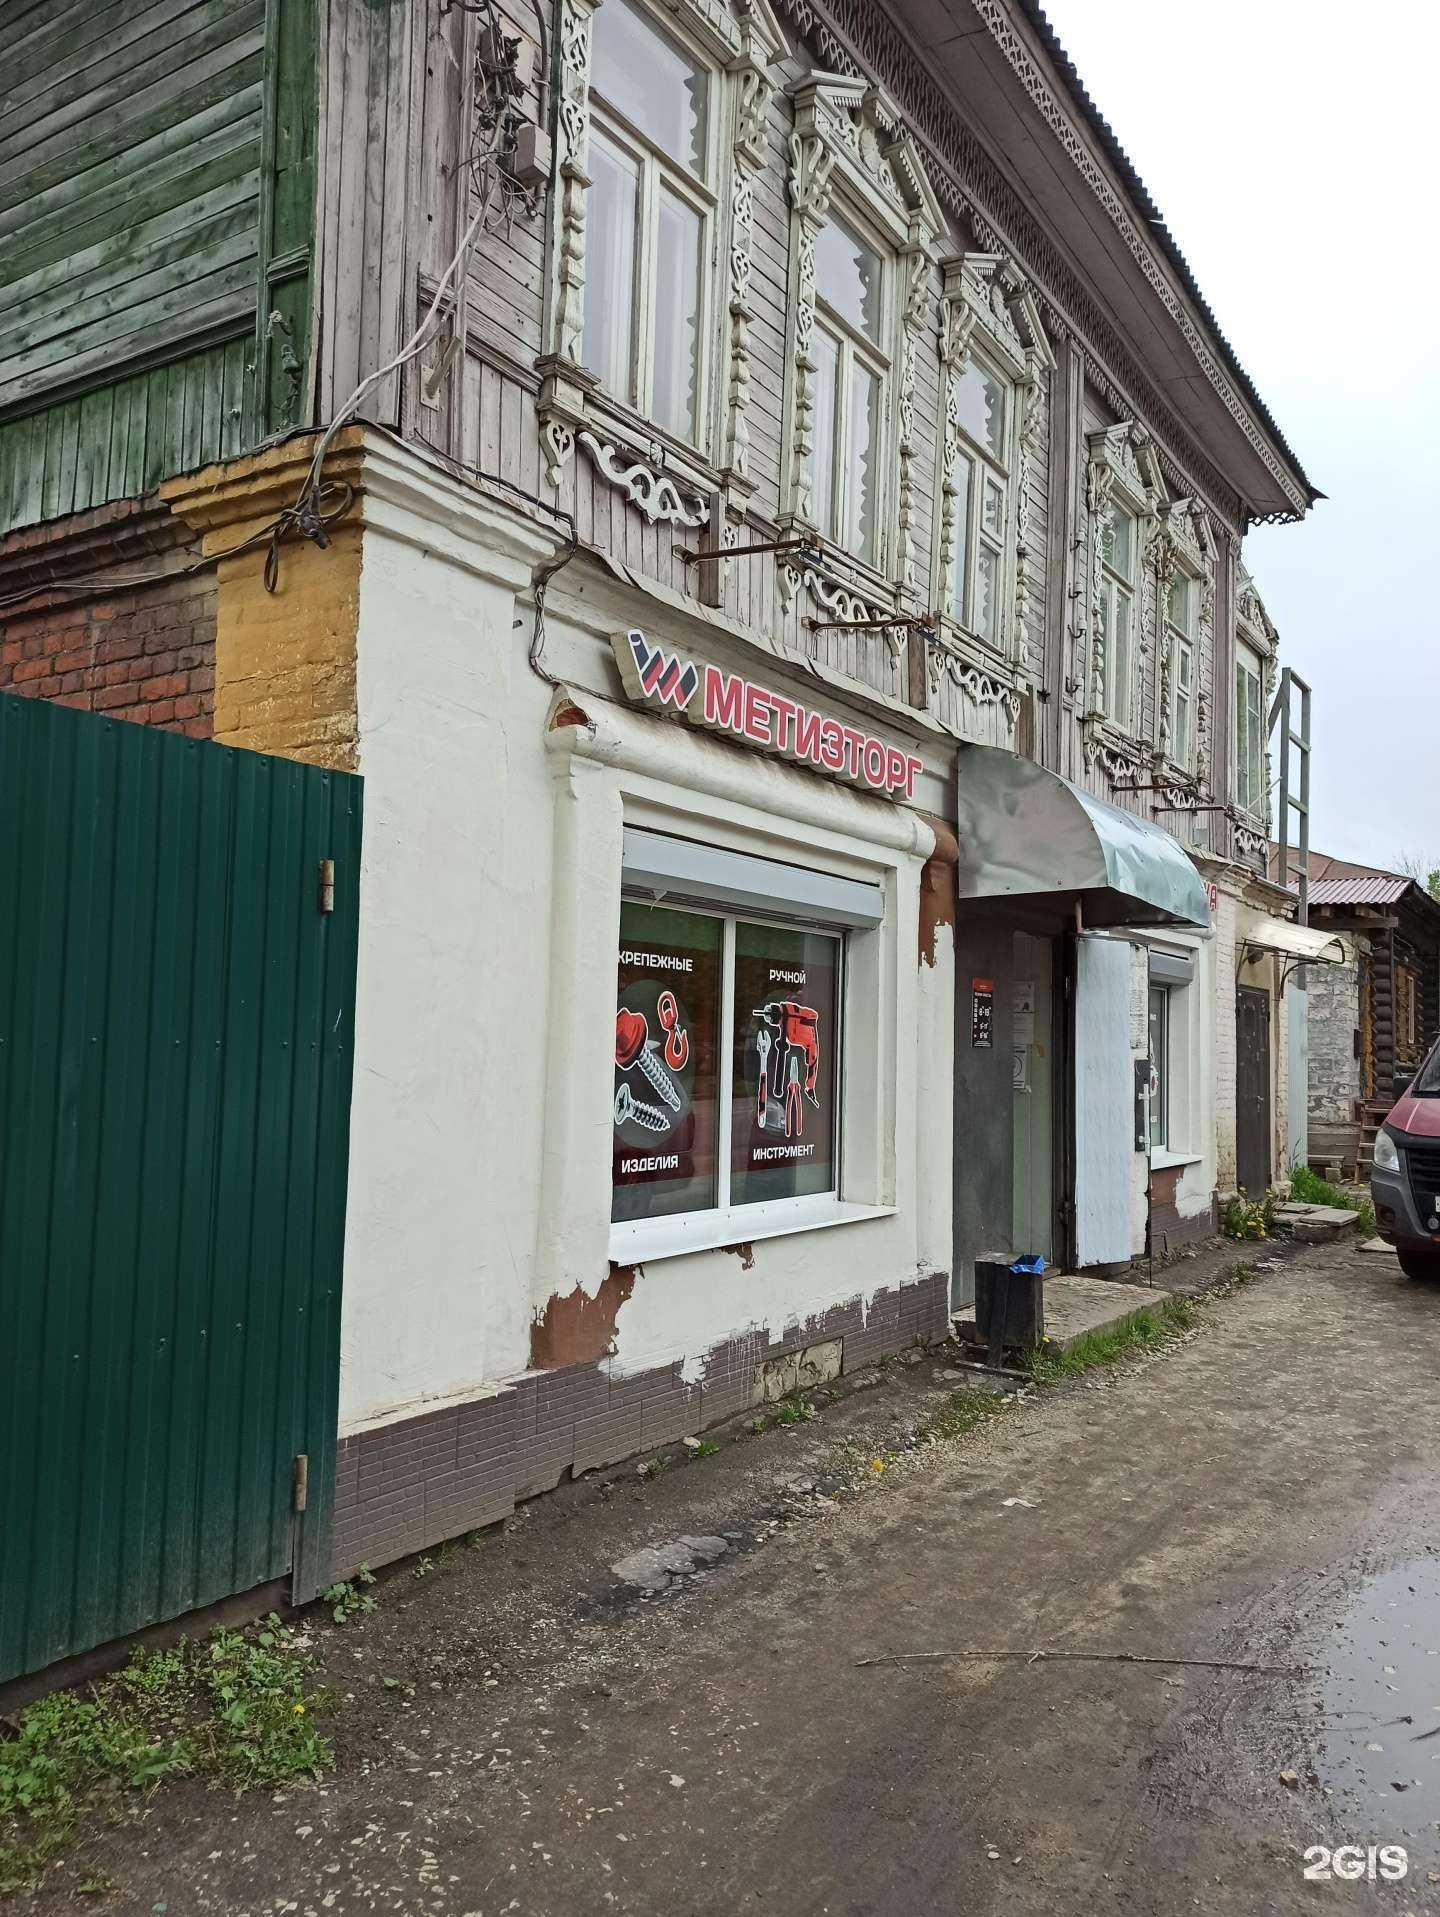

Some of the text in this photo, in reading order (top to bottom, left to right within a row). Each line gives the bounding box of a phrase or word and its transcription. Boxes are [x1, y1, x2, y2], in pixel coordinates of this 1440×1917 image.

[704, 664, 923, 800] МЕТИЗТОРГ
[769, 969, 806, 985] РУЧНОЙ
[753, 1143, 815, 1161] ИНСТРУМЕНТ
[621, 1154, 679, 1174] ИЗДЕЛИЯ
